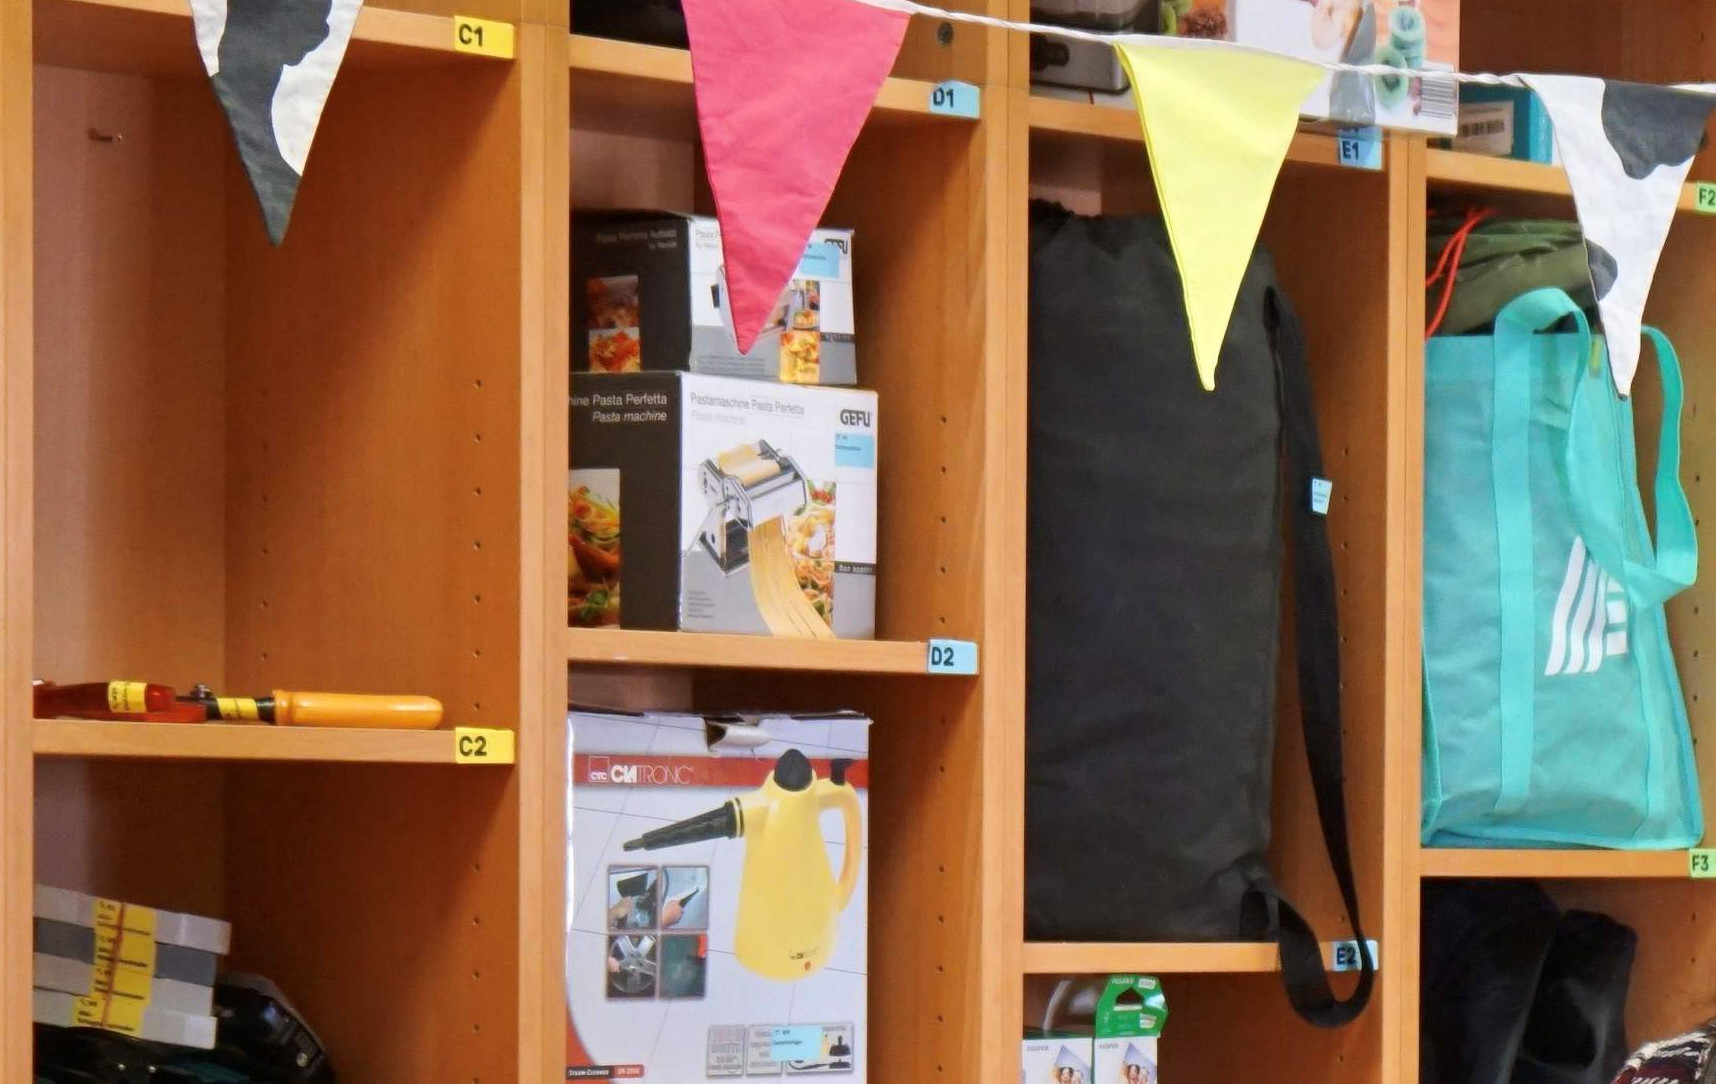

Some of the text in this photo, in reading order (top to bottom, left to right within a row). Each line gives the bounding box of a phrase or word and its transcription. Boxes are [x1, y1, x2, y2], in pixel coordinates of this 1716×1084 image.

[458, 24, 483, 47] C1
[933, 87, 954, 108] D1
[1341, 140, 1359, 160] E1
[1699, 187, 1716, 206] F2
[592, 393, 623, 406] Pasta
[625, 392, 668, 405] Perfetta
[592, 410, 667, 423] Pasta machine
[840, 408, 872, 428] GEFU
[931, 646, 955, 667] D2
[459, 735, 486, 757] C2
[1691, 854, 1709, 872] F3
[1336, 946, 1357, 967] E2
